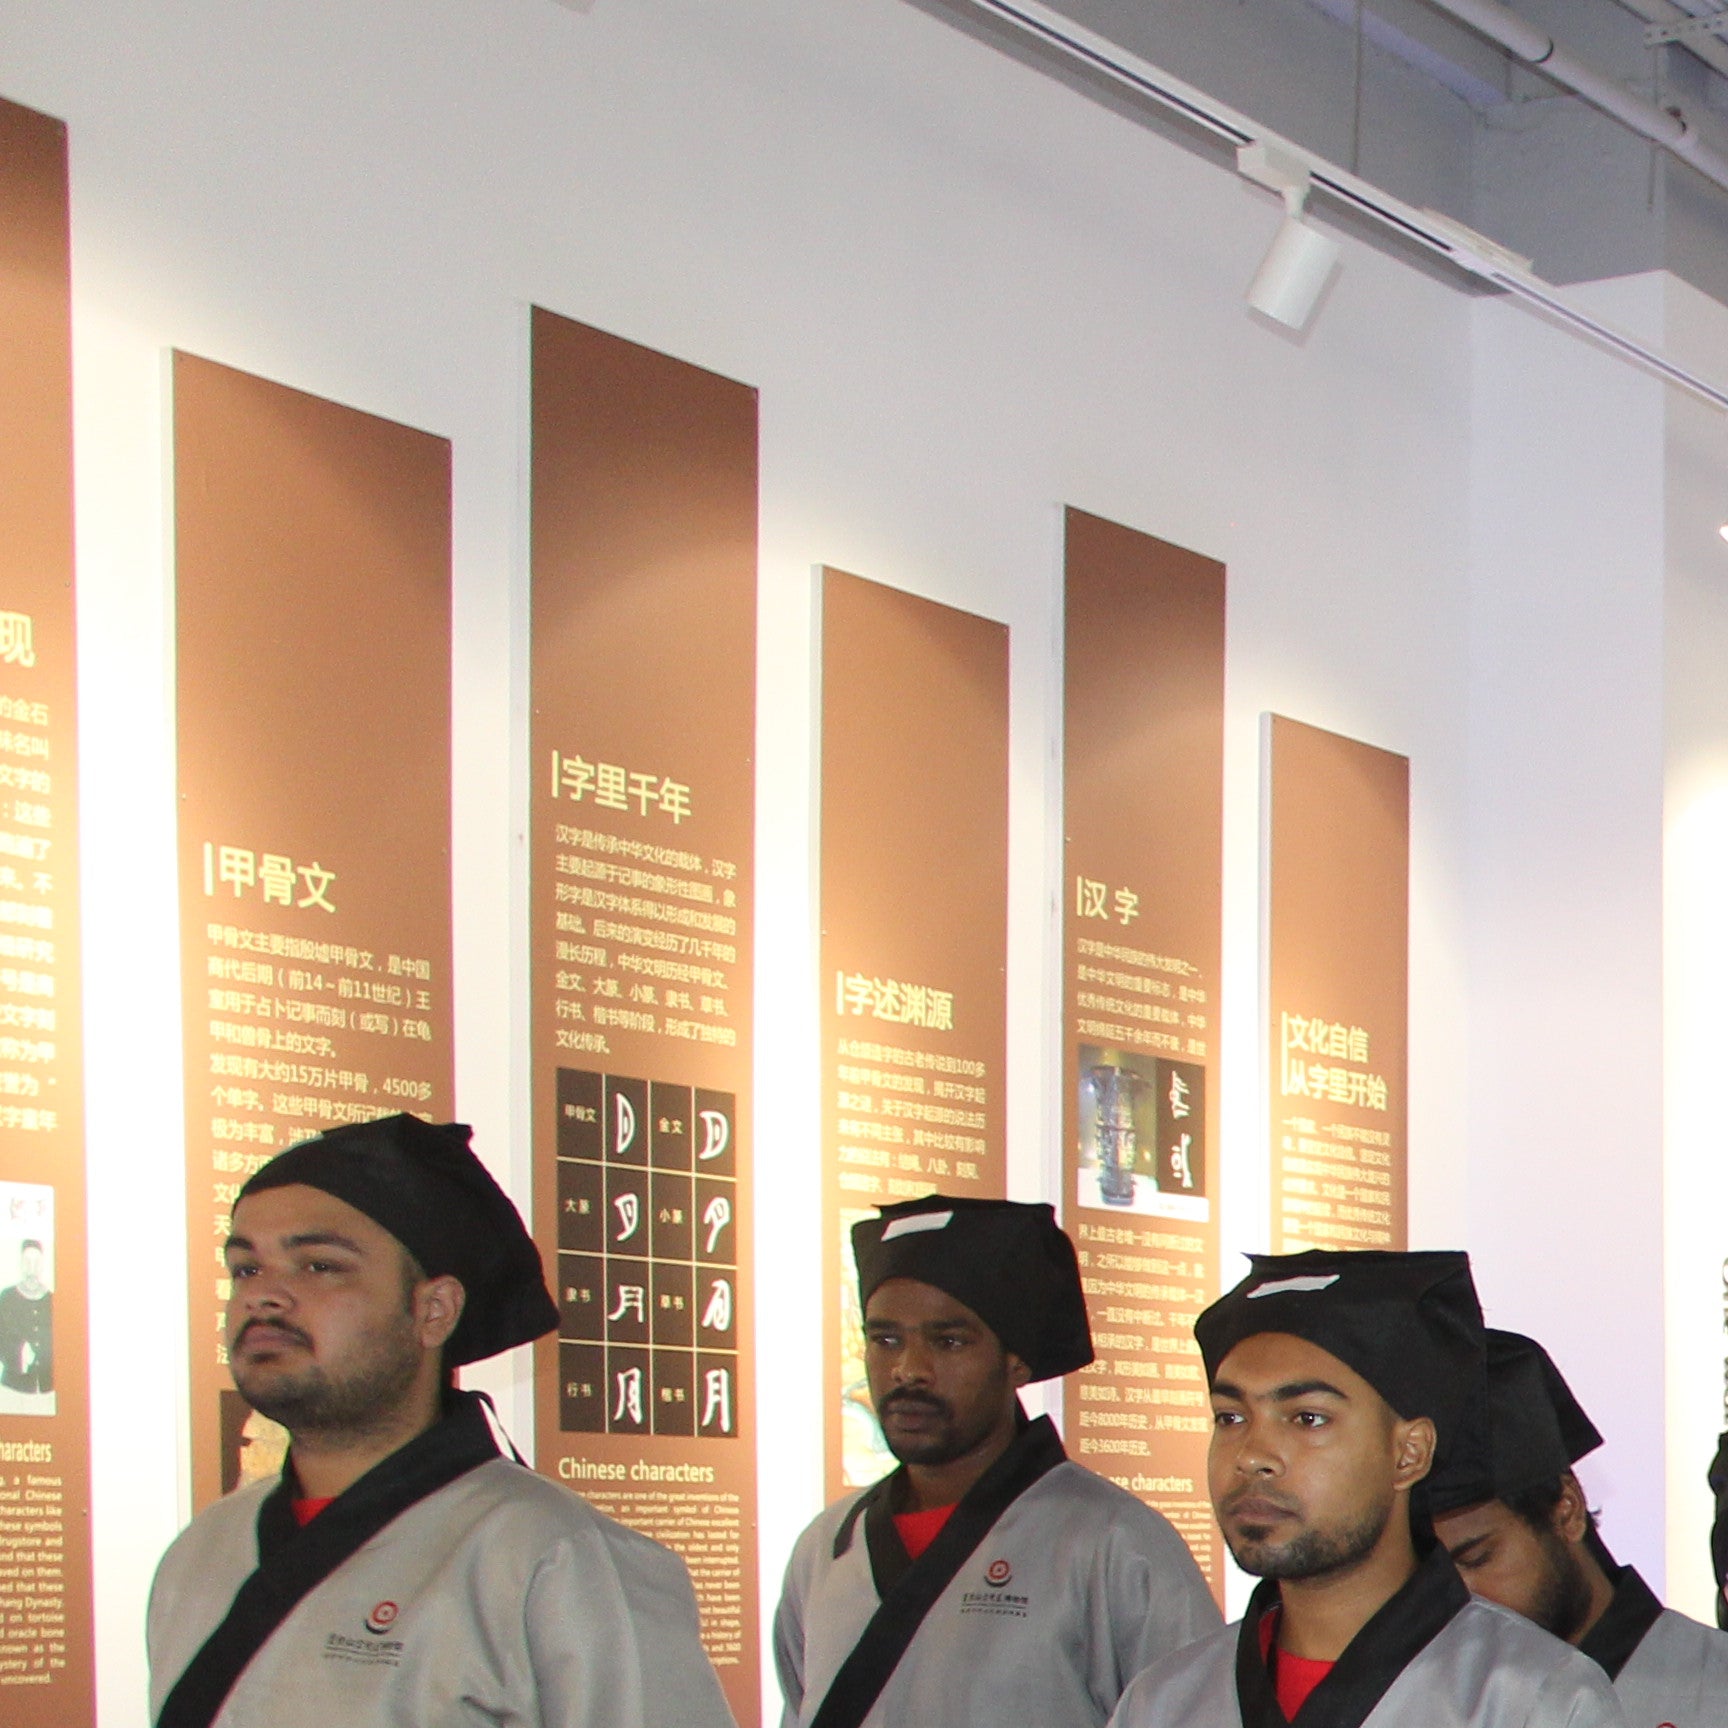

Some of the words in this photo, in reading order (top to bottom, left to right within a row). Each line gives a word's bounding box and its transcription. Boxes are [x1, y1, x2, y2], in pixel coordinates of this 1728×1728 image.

[560, 755, 692, 825] 字里千年
[218, 845, 337, 914] 甲骨文
[1084, 879, 1139, 925] 汉字
[845, 972, 954, 1031] 字述渊源
[1288, 1014, 1370, 1063] 文化自信
[1288, 1059, 1389, 1111] 从字里开始
[558, 1458, 626, 1481] Chinese
[631, 1459, 715, 1483] characters
[1131, 1472, 1194, 1493] characters
